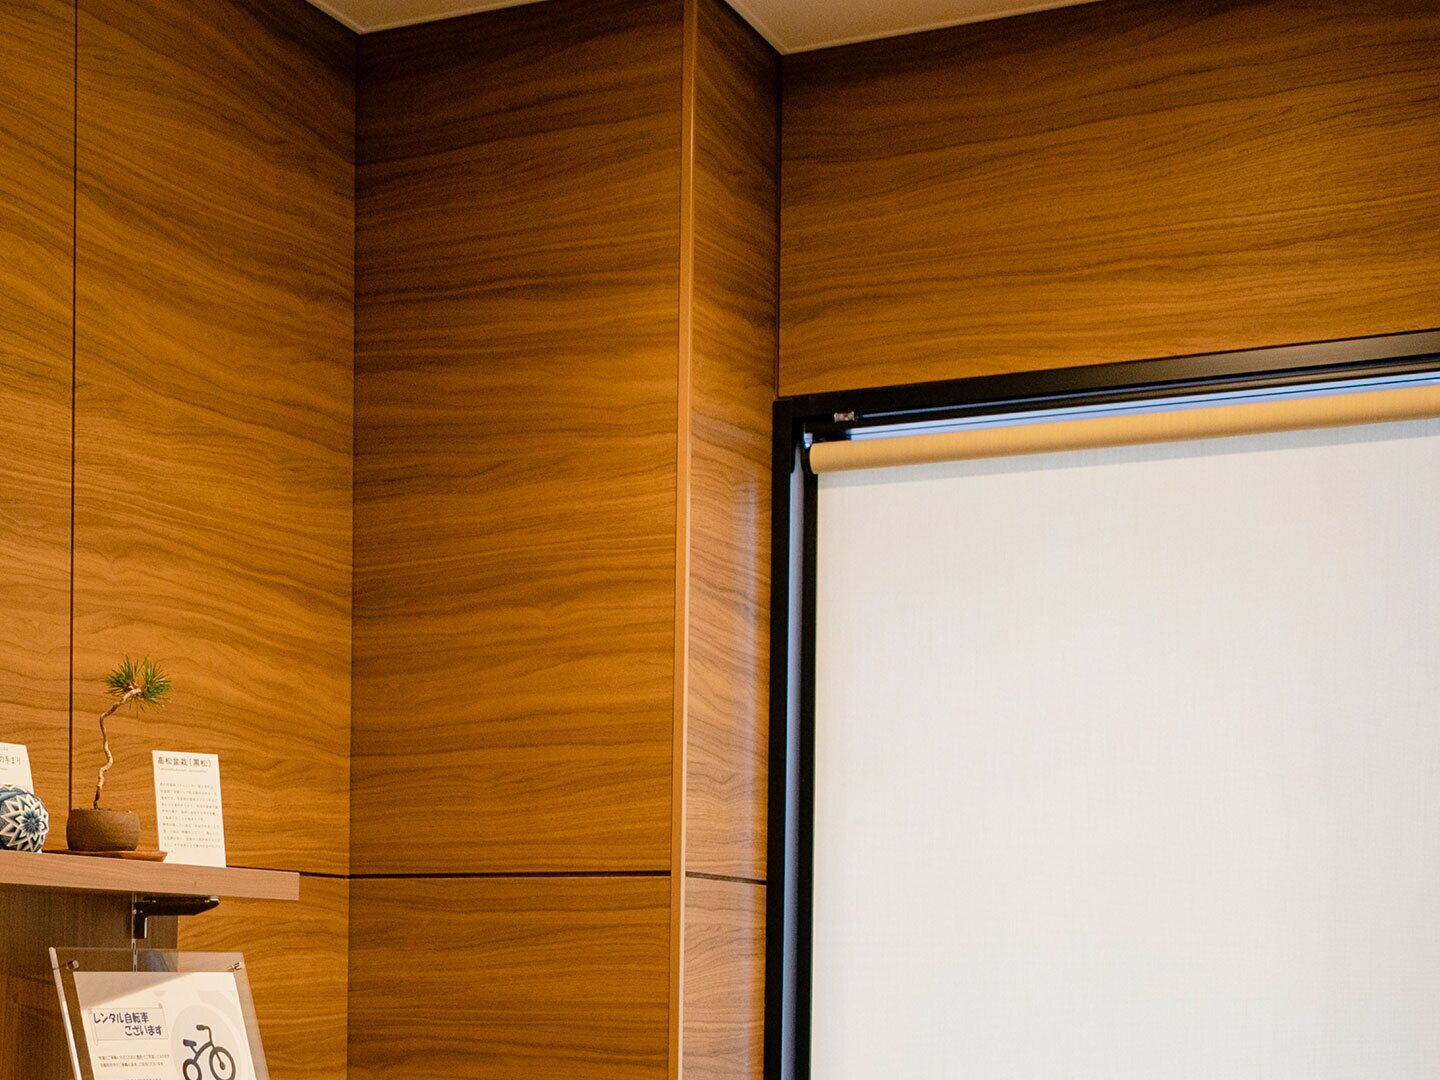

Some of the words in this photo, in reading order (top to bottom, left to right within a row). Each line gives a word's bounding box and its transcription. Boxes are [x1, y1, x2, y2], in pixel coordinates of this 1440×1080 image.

[93, 1012, 149, 1024] レンタル自転車
[125, 1025, 162, 1036] ございます
